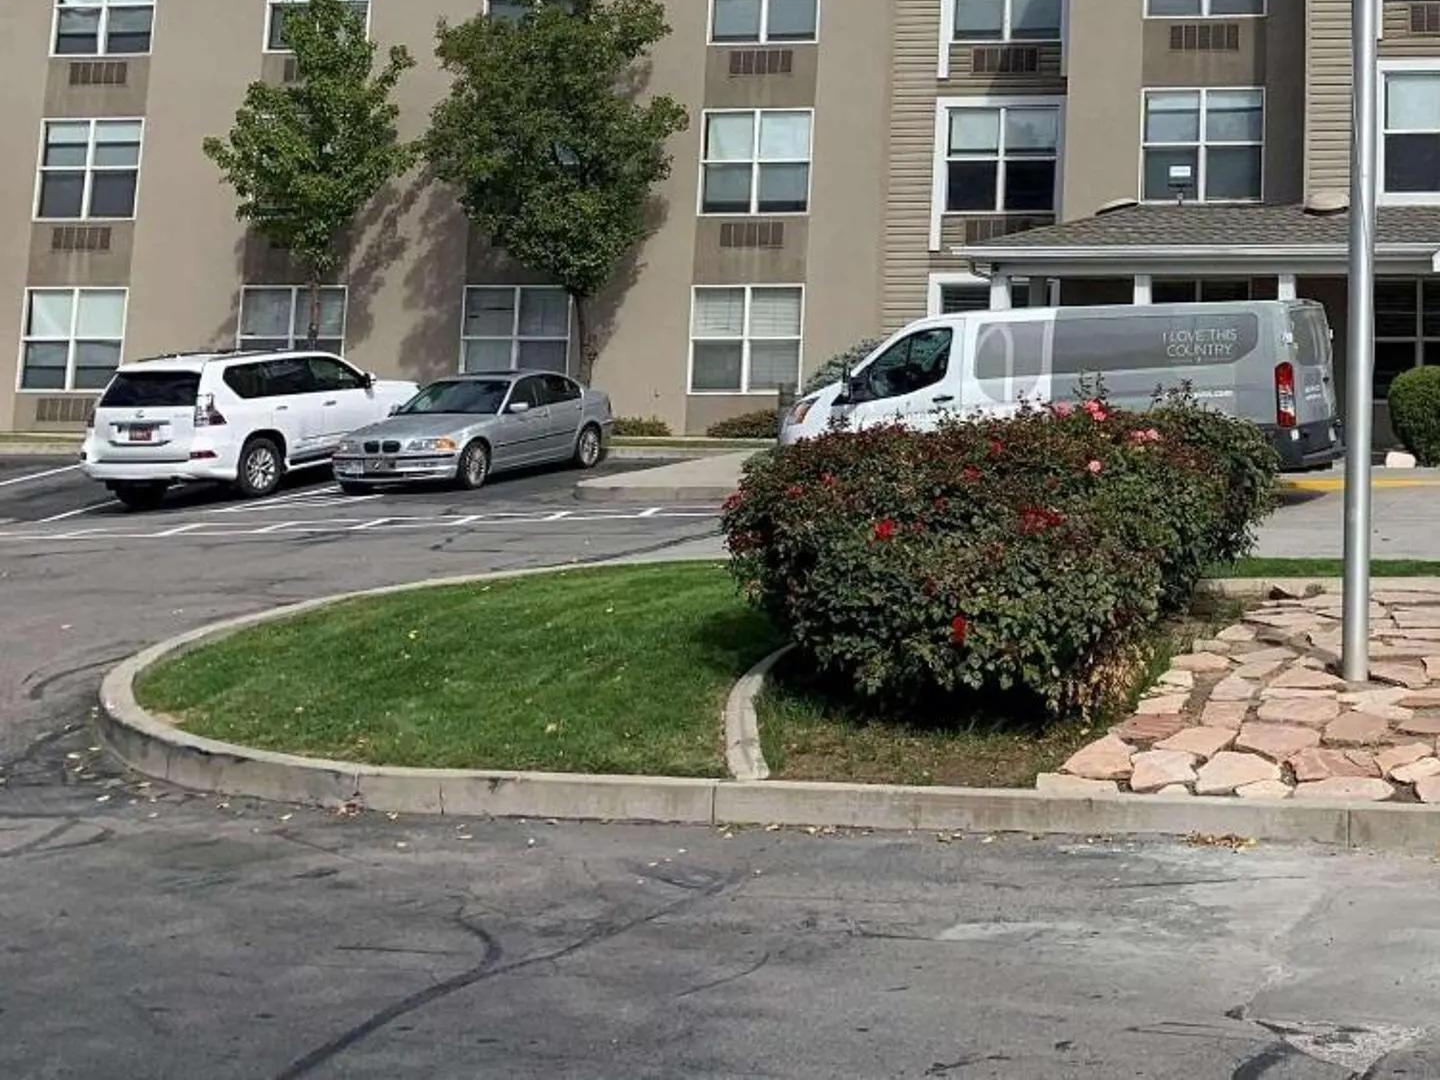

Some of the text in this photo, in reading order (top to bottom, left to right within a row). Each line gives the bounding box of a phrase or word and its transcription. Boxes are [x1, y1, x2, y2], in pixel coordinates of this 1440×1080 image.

[1168, 329, 1205, 342] LOVE
[1210, 328, 1237, 341] THIS
[1167, 343, 1232, 357] COUNTRY
